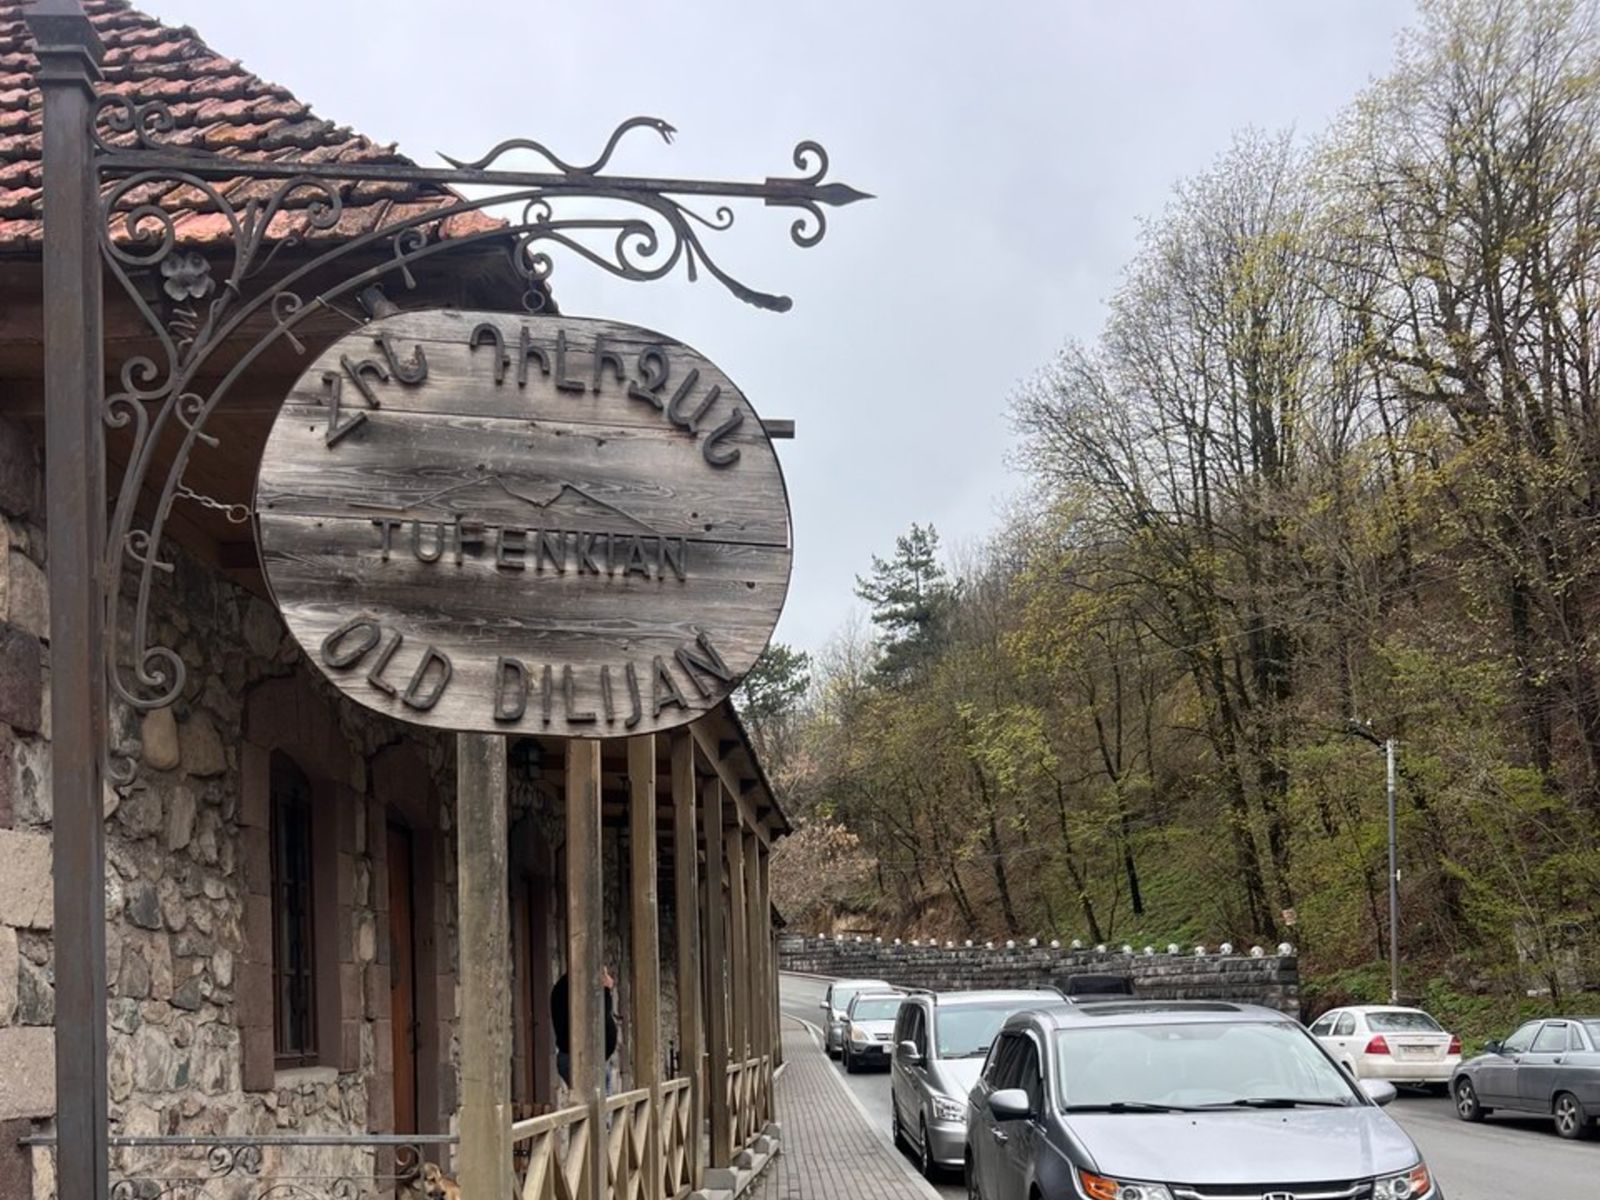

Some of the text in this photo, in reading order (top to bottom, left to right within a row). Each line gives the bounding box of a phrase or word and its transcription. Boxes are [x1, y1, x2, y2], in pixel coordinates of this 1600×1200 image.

[373, 515, 687, 582] TUFENKIAN
[321, 616, 735, 728] OLD DILIJAN
